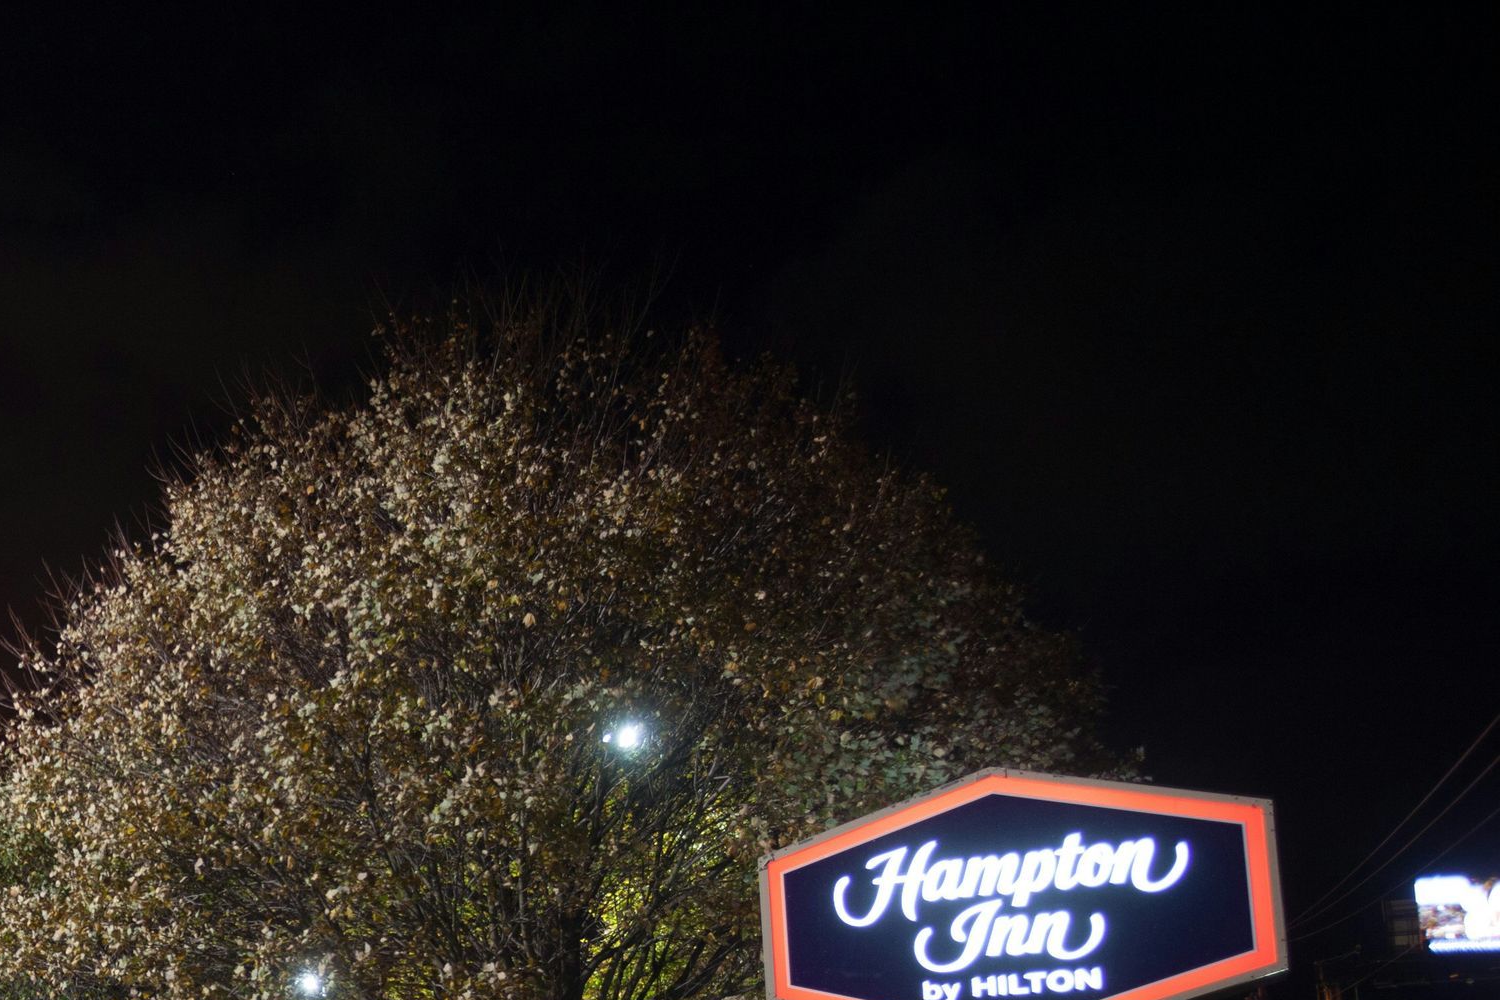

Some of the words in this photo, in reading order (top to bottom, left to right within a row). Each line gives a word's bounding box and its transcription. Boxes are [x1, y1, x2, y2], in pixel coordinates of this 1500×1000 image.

[833, 831, 1190, 928] Hampton
[913, 898, 1106, 974] Inn
[970, 966, 1104, 998] HILTON
